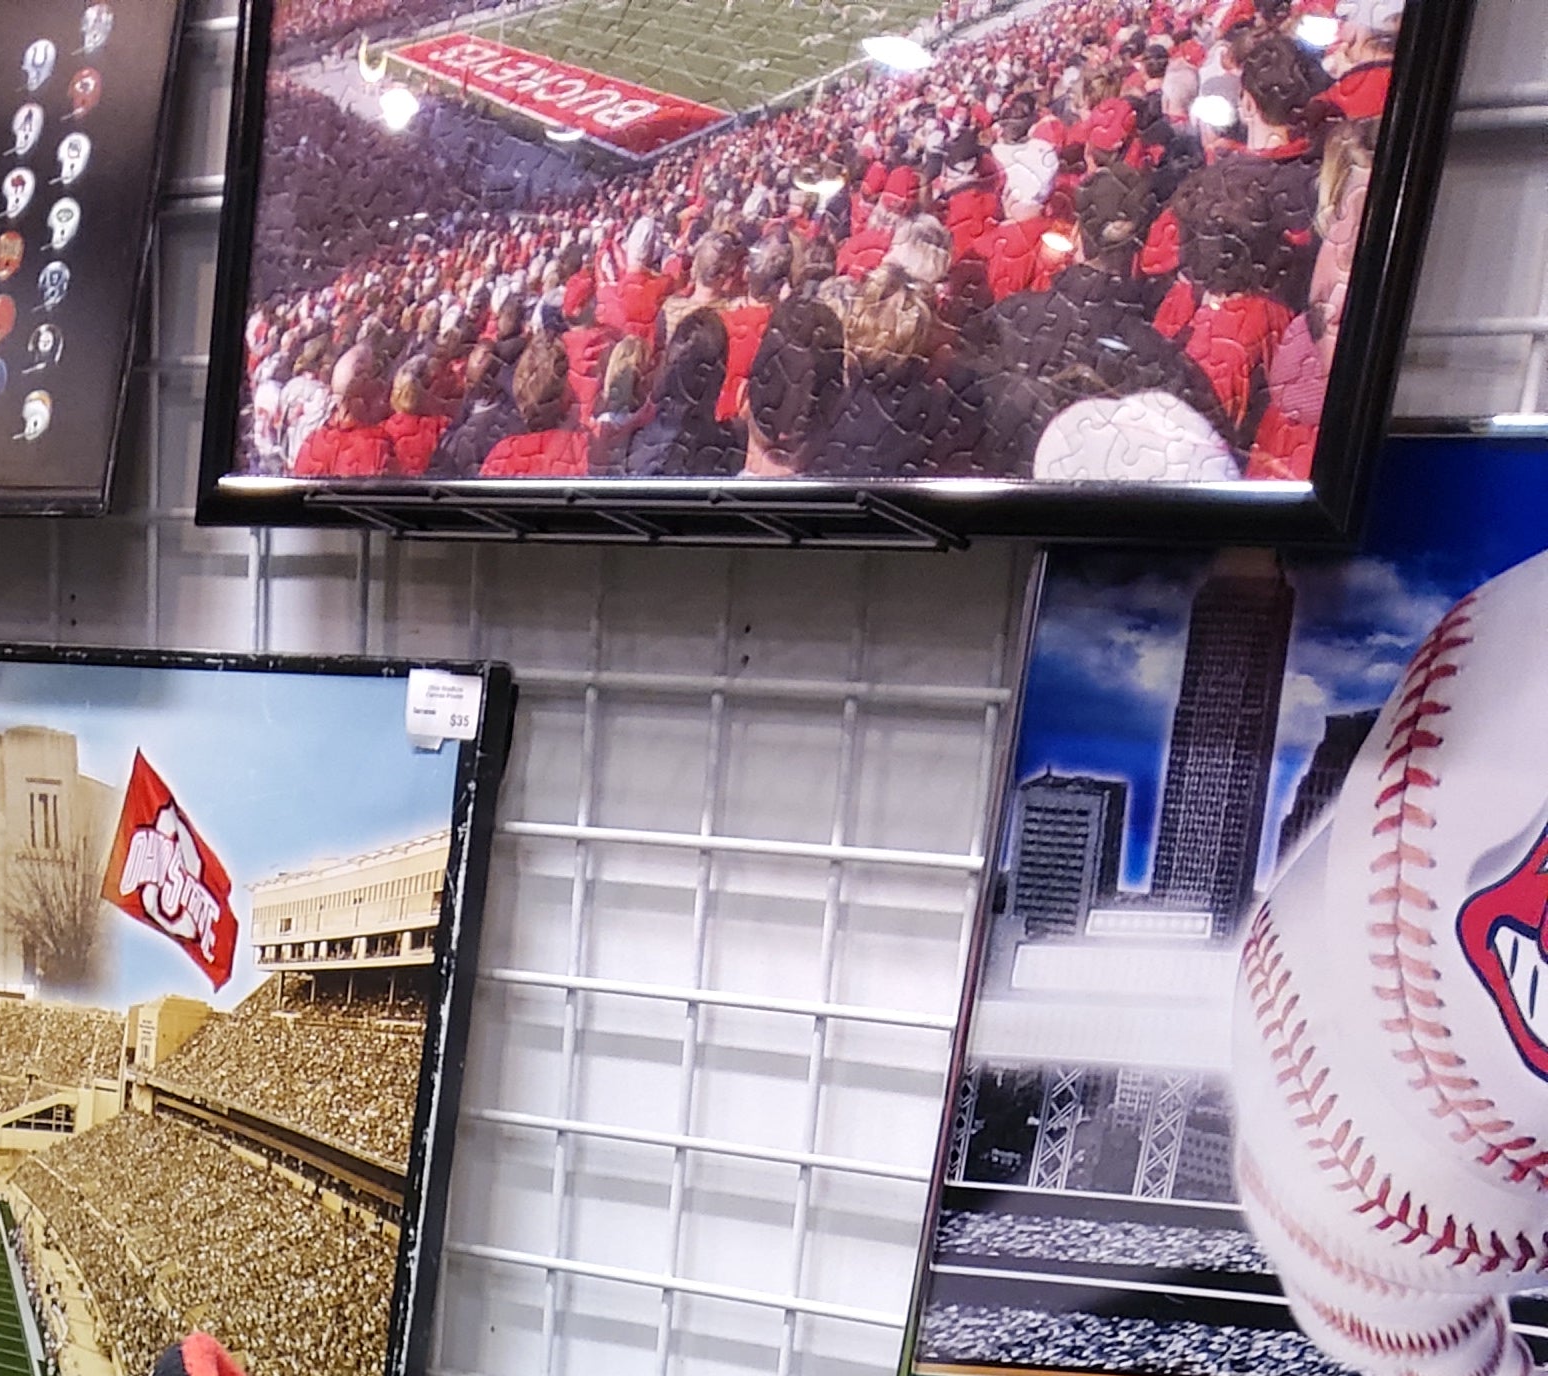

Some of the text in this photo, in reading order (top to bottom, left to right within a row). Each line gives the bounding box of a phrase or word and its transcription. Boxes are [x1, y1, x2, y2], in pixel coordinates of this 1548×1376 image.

[428, 43, 660, 127] BUCKEYES
[450, 713, 470, 727] $35
[119, 830, 220, 964] OHIO STATE
